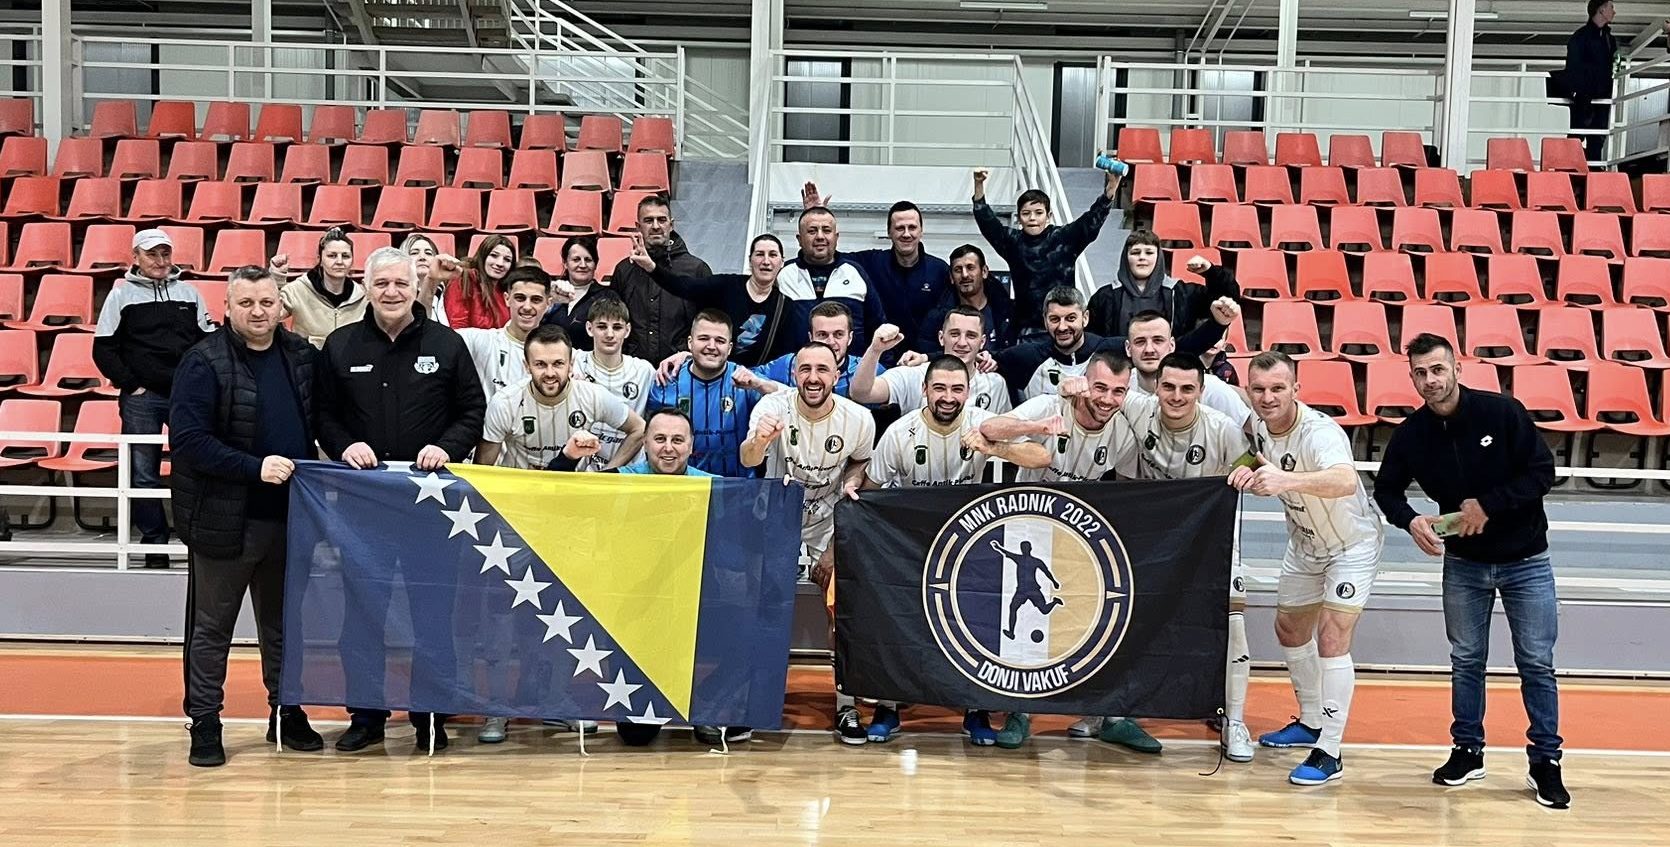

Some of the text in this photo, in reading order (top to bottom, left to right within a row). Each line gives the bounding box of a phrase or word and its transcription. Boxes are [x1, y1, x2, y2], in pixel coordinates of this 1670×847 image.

[958, 493, 1102, 538] MNK RADNIK 2022
[977, 660, 1070, 692] DONJI VAKUF
